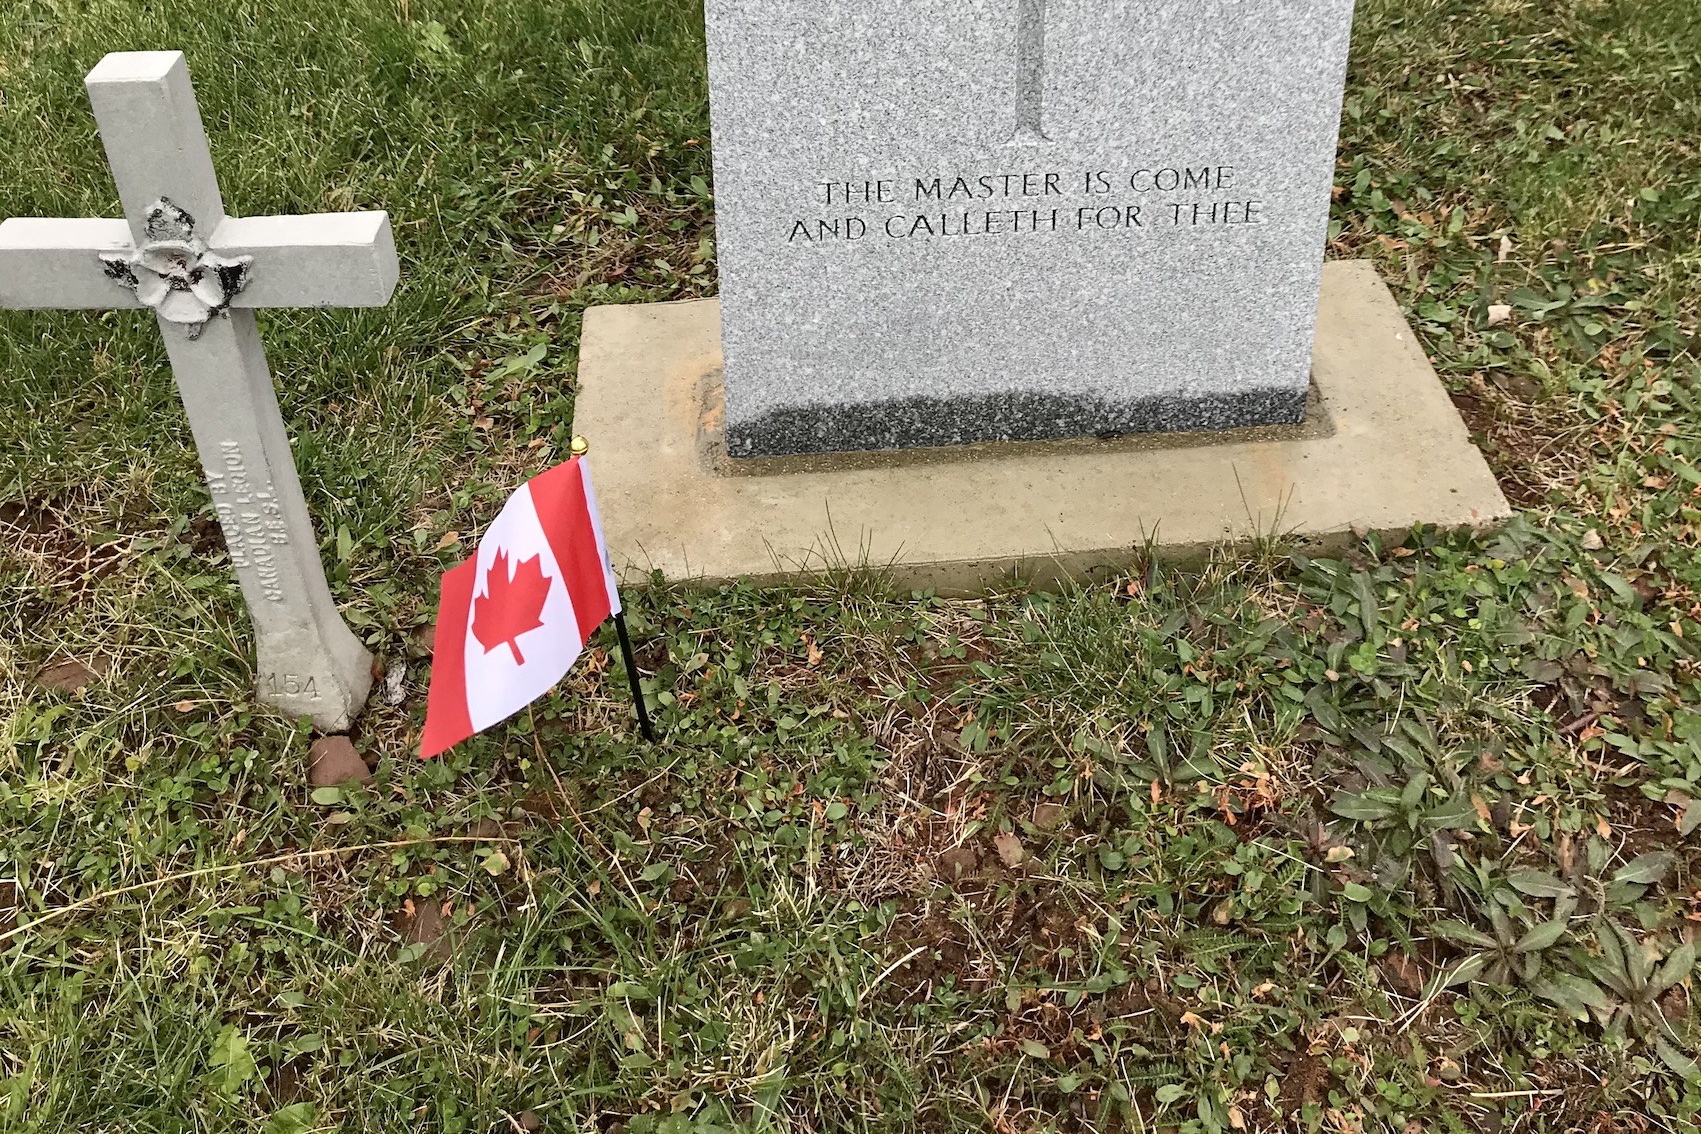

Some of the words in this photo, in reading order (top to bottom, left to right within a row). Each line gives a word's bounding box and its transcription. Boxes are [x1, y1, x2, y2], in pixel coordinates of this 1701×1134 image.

[818, 178, 896, 206] THE
[914, 172, 1062, 203] MASTER
[1084, 170, 1111, 195] IS
[1129, 165, 1234, 194] COME
[787, 216, 867, 244] AND
[884, 207, 1059, 240] CALLETH
[1076, 204, 1144, 231] FOR
[1168, 200, 1263, 227] THEE
[204, 469, 228, 494] BY
[219, 440, 253, 504] LEGION
[215, 502, 250, 567] PLACED
[240, 512, 284, 601] CANADIAN
[266, 672, 323, 701] 154
